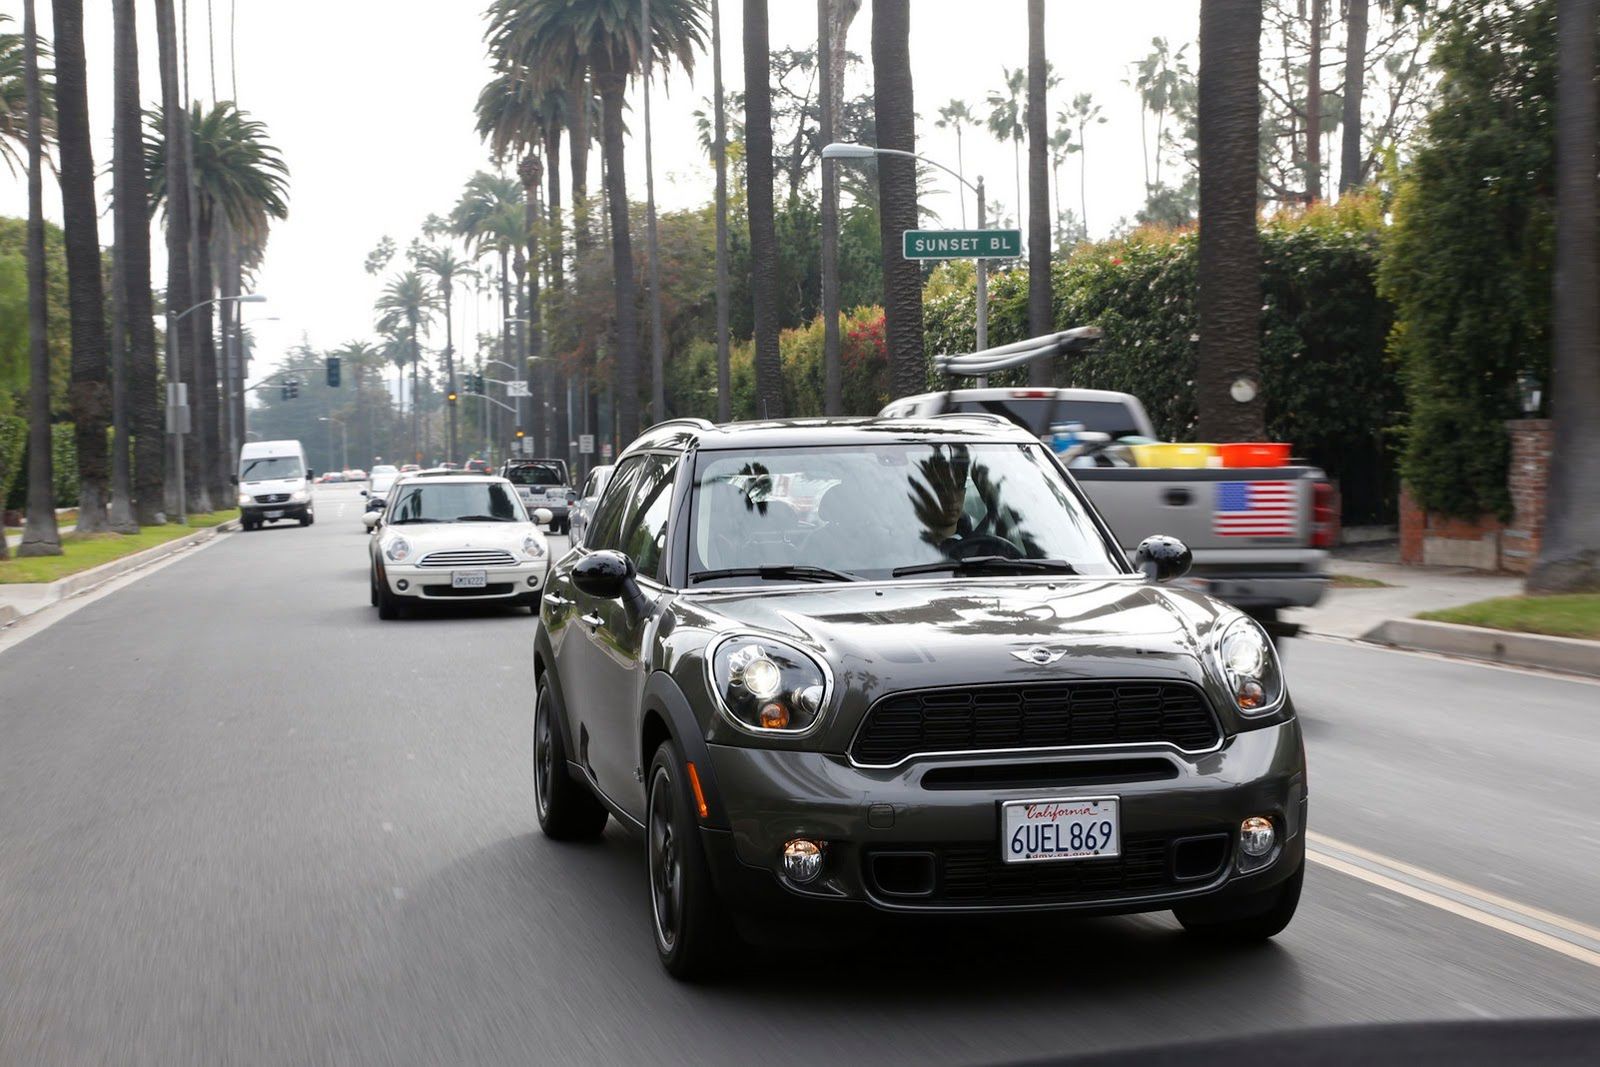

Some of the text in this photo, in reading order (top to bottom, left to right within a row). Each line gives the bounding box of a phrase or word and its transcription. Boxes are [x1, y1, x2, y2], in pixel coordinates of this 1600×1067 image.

[915, 237, 1012, 252] SUNSET BL
[1026, 802, 1098, 821] California
[1011, 821, 1112, 854] 6UEL869
